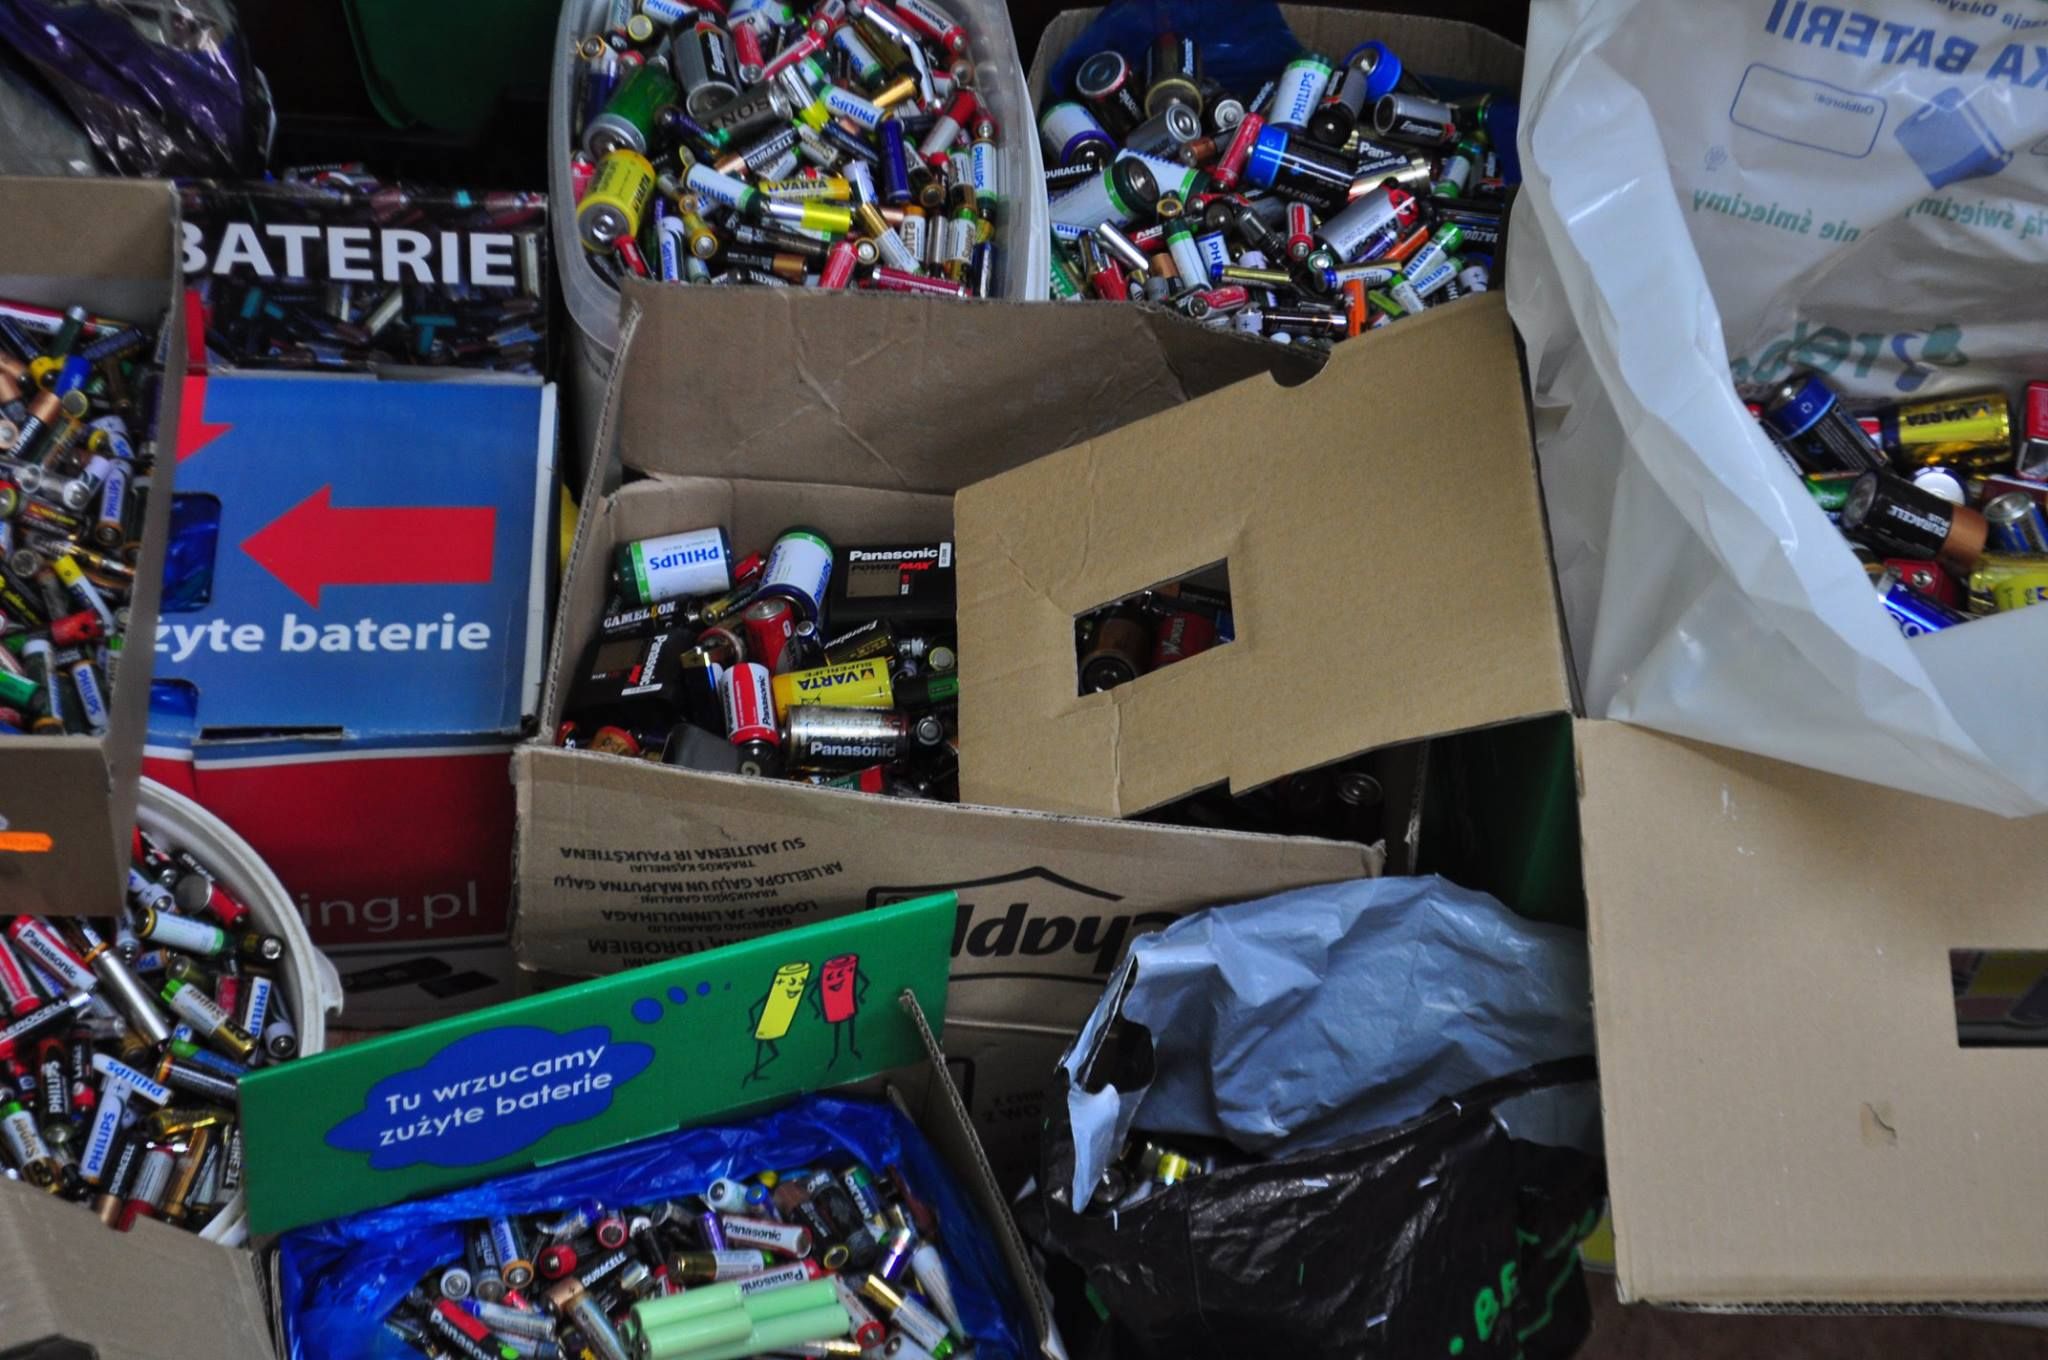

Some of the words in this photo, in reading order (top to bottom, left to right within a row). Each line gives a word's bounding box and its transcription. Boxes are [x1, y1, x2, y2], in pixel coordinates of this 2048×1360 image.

[646, 0, 685, 17] PHILIP
[829, 95, 876, 125] PHILIPS
[1290, 71, 1316, 123] PHILIPS
[746, 134, 796, 169] DURACELL
[975, 146, 984, 188] PHILIPS
[1043, 162, 1094, 179] DURACELL
[690, 178, 736, 208] PHILIPS
[1462, 229, 1499, 244] BAZOO
[182, 222, 517, 287] BATERIE
[1404, 245, 1436, 277] HILIPS
[1887, 504, 1949, 539] DURACELL
[649, 546, 720, 571] PHILIPS
[849, 547, 939, 562] Panasonic
[154, 613, 265, 663] żyte
[280, 612, 492, 653] baterie
[76, 668, 102, 717] PHILIPS
[797, 668, 860, 692] VARTA
[762, 675, 773, 727] Panasonic
[810, 740, 897, 758] Panasonic
[560, 847, 672, 863] PAUKŠTIENA
[673, 849, 692, 861] IR
[694, 841, 777, 860] JAUTIENA
[782, 837, 806, 852] SU
[754, 866, 823, 888] LIELLOPA
[821, 861, 844, 876] AR
[553, 874, 596, 891] GAĻU
[599, 880, 684, 894] MĀJPUTNA
[685, 880, 709, 893] UN
[711, 876, 753, 890] GAĻU
[601, 910, 722, 923] LINNULIHAGA
[725, 909, 745, 919] JA
[22, 928, 78, 981] Panasonic
[588, 939, 696, 955] DROBIEM
[250, 983, 268, 1038] PHILIP
[41, 1059, 62, 1115] PHILIPS
[105, 1059, 166, 1098] PHILIPS
[385, 1093, 421, 1116] Tu
[432, 1044, 606, 1103] wrzucamy
[379, 1106, 485, 1147] zużyte
[496, 1072, 614, 1117] baterie
[87, 1110, 117, 1173] PHILIPS
[108, 1143, 137, 1196] DURACELL
[723, 1220, 782, 1242] Panasonic
[580, 1250, 628, 1288] DURACELL
[429, 1309, 499, 1360] Panason
